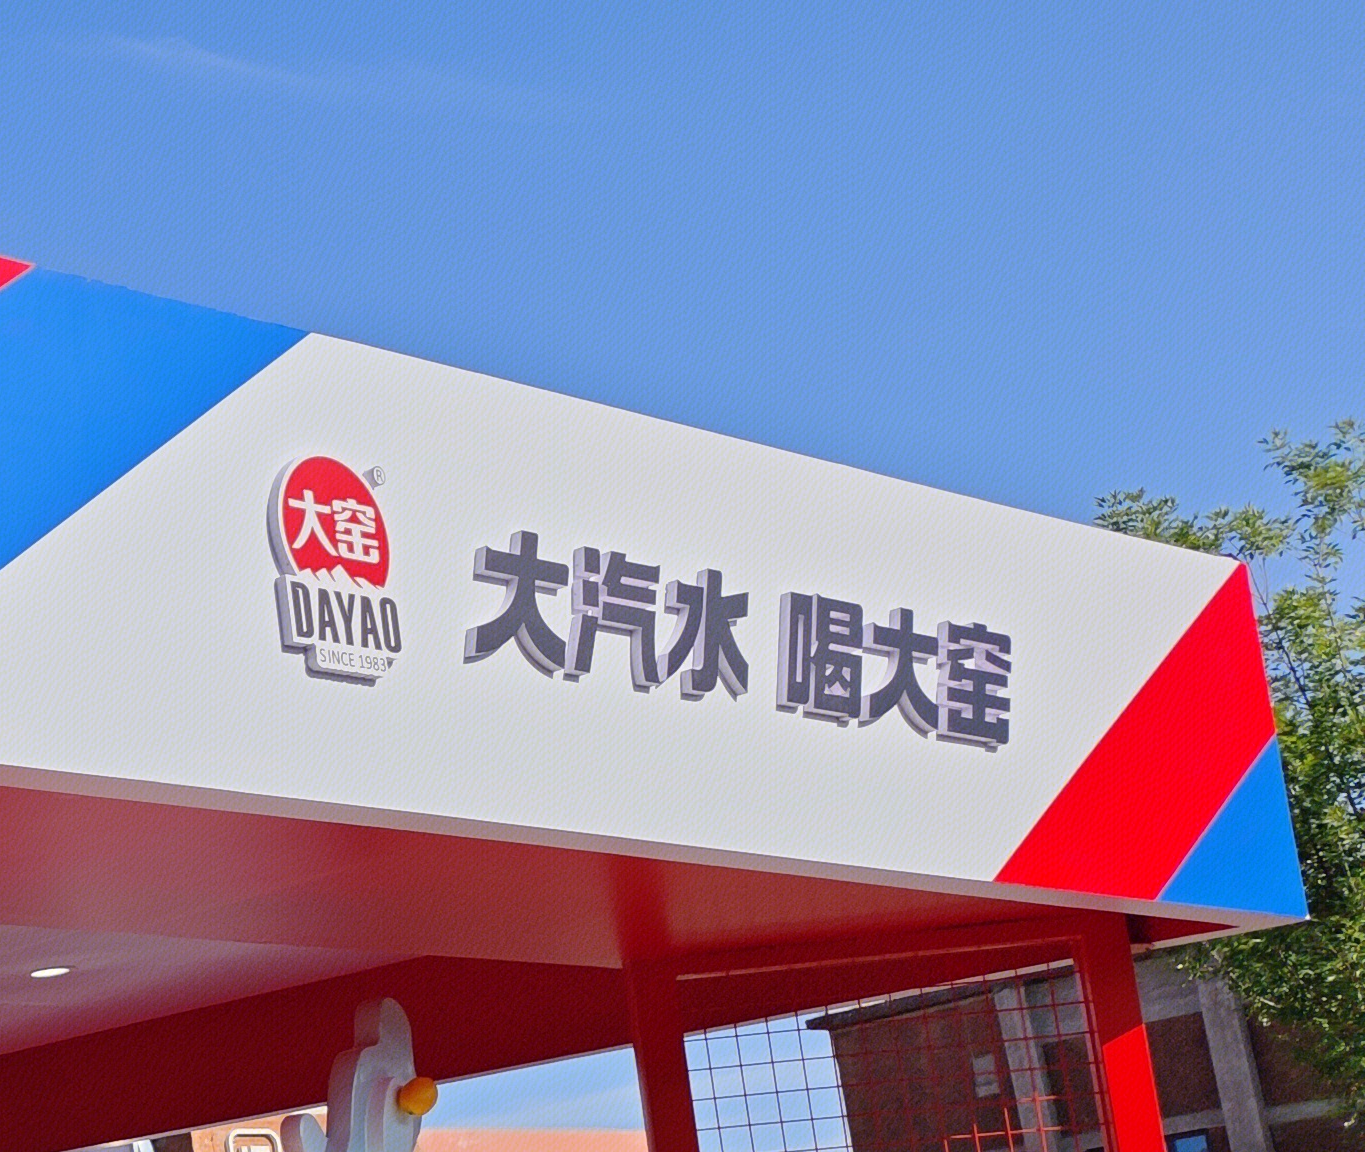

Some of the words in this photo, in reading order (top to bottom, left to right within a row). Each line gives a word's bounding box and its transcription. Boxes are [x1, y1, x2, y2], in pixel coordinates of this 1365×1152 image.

[287, 488, 380, 564] 大窑
[291, 592, 402, 655] DAYAO
[465, 531, 750, 700] 大汽水
[777, 592, 1012, 750] 喝大窑
[318, 646, 356, 667] SINCE
[358, 650, 388, 674] 1983
